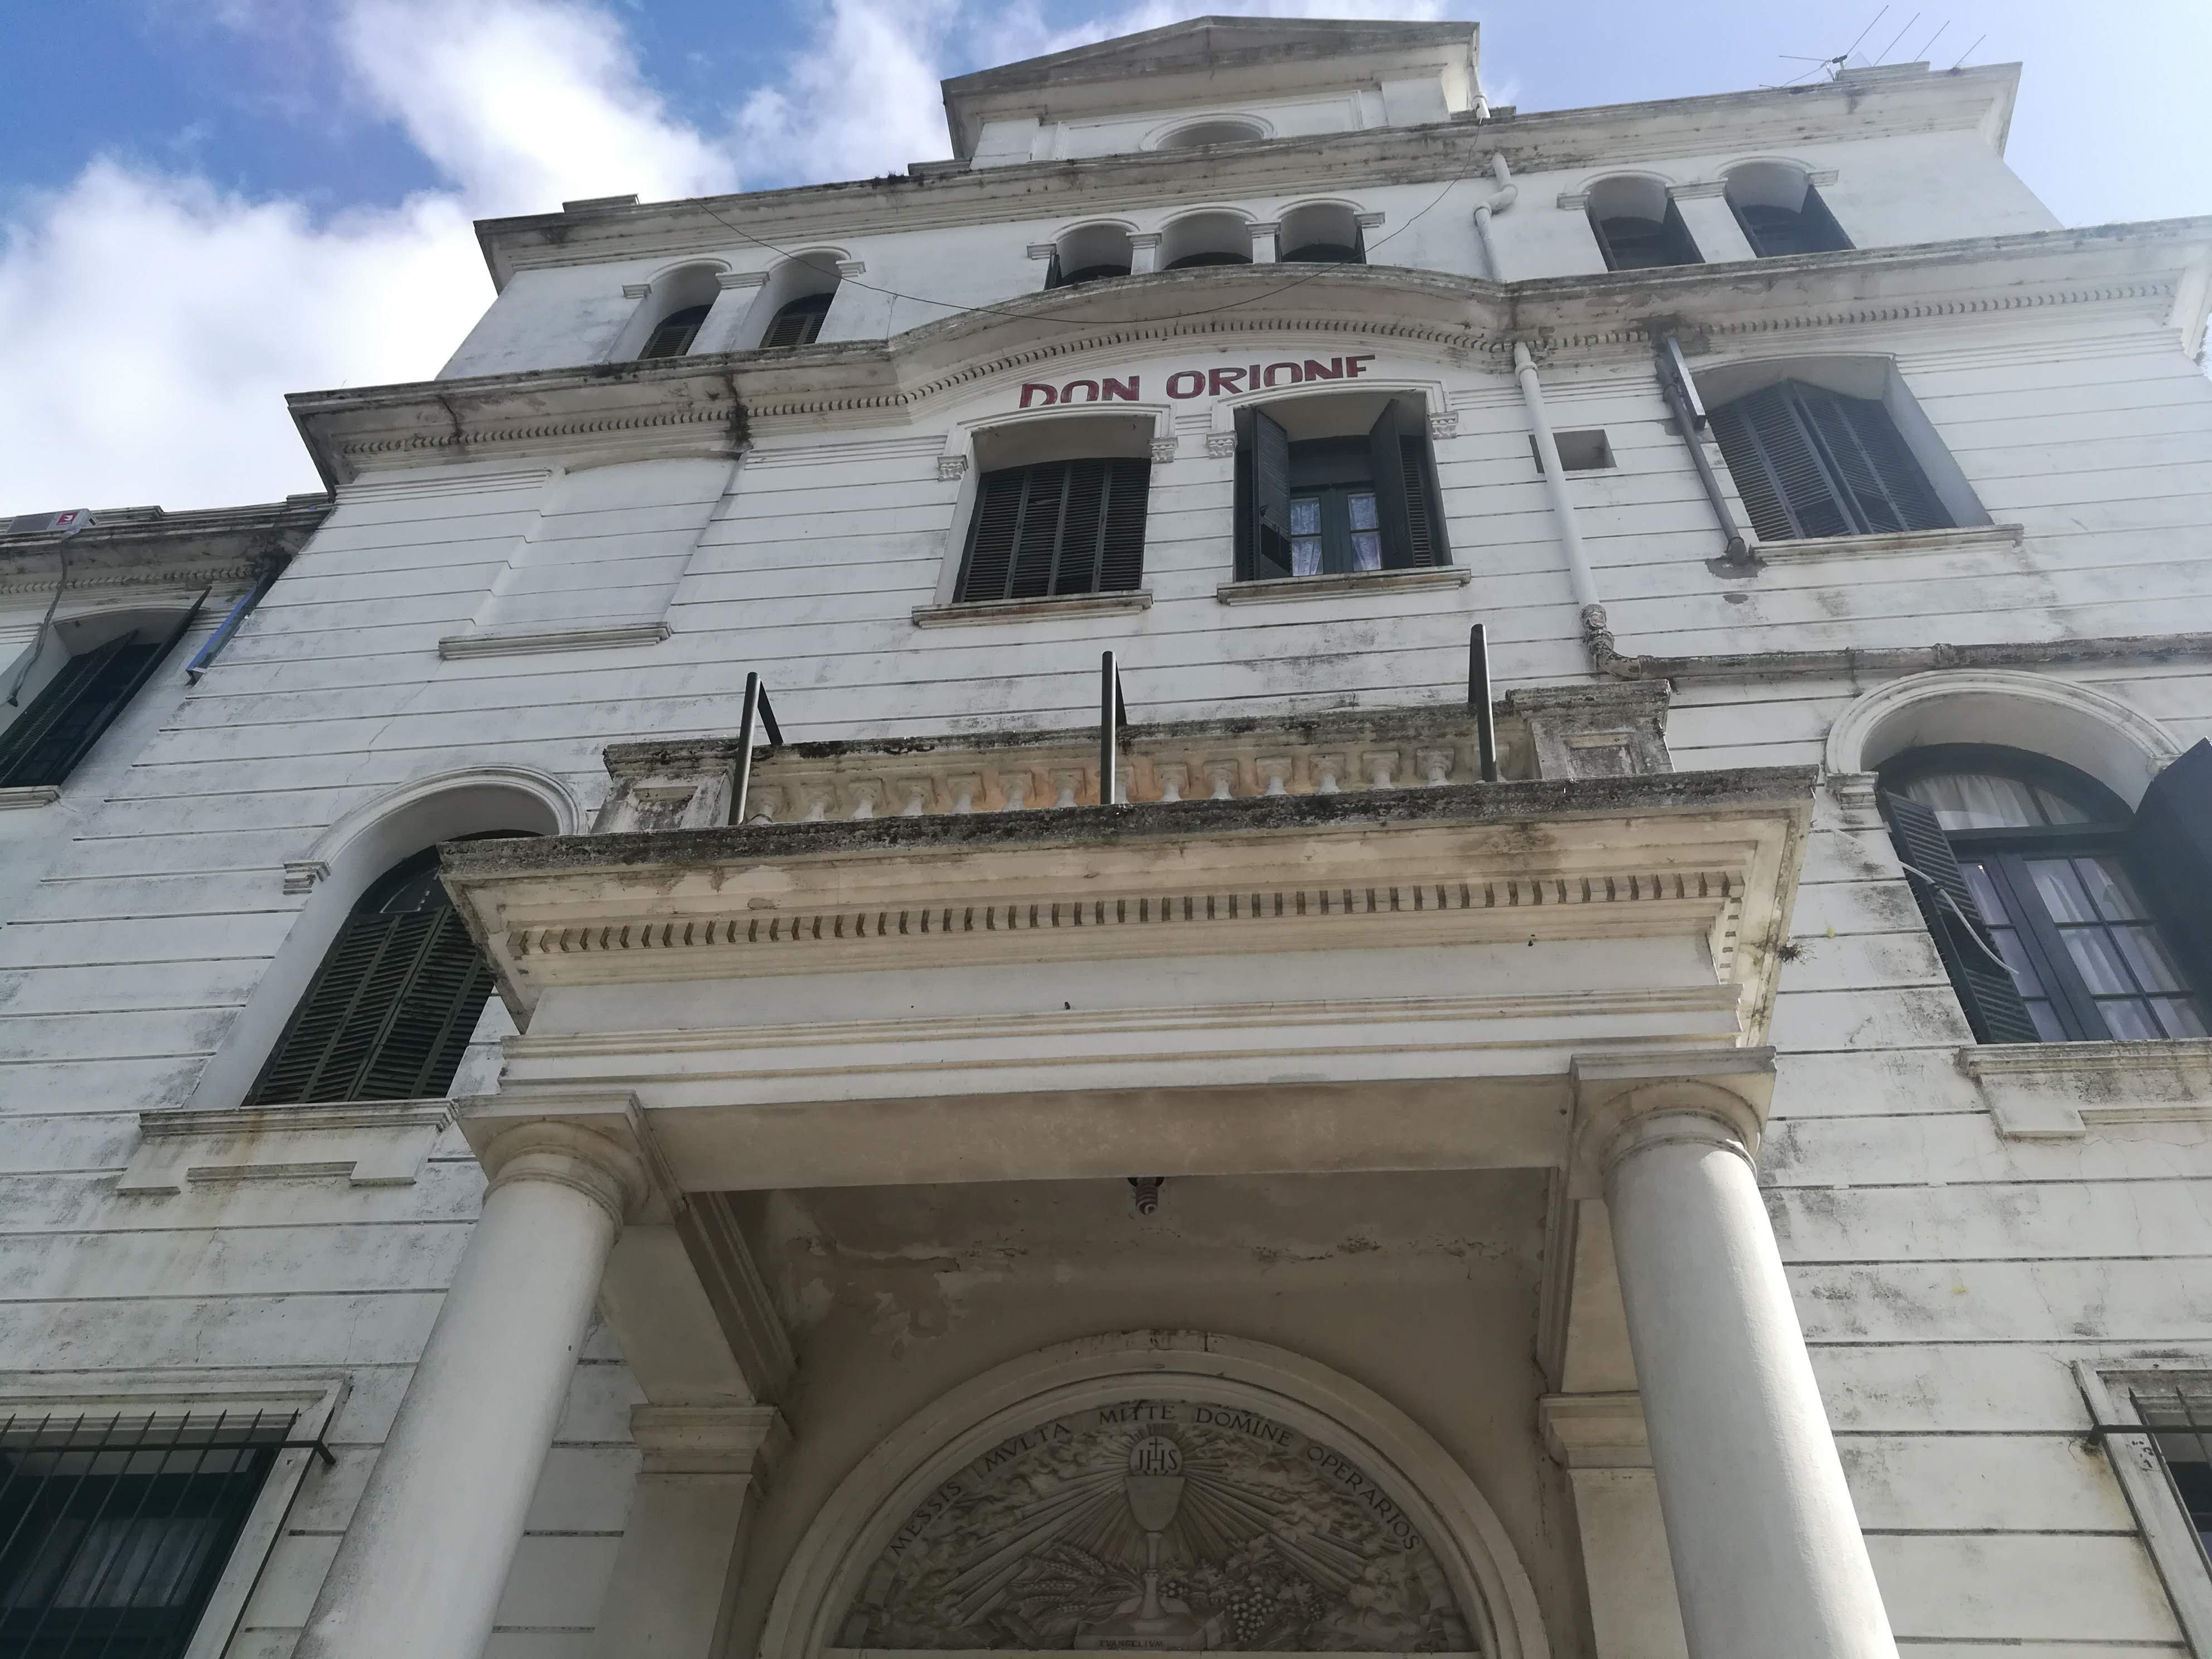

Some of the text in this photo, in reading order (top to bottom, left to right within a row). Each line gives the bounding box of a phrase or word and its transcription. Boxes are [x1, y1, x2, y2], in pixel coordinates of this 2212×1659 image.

[1019, 375, 1139, 409] DON
[890, 1404, 1421, 1557] MESSIS MVLTA MITTE DOMINE OPERARIOS
